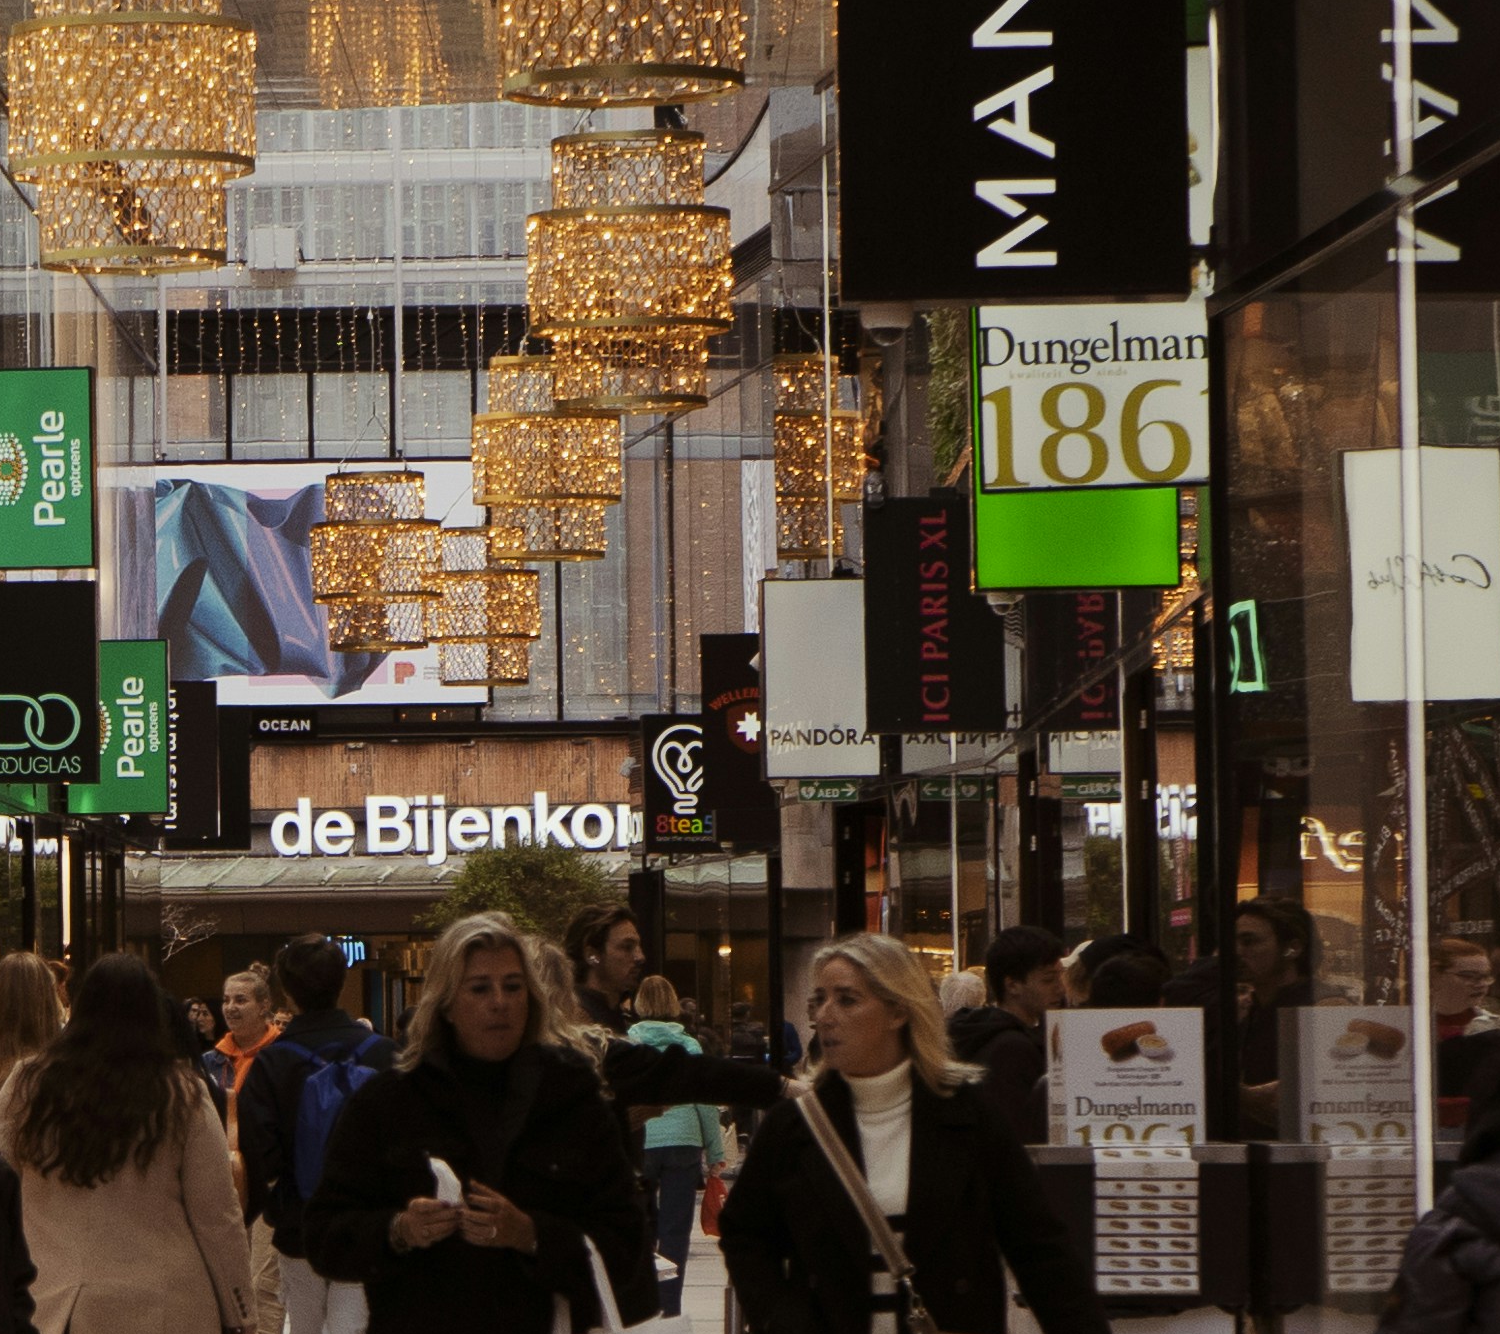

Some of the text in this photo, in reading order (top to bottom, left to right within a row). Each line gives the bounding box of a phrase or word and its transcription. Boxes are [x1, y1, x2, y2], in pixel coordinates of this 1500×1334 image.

[982, 379, 1209, 487] 186
[33, 410, 67, 527] Pearle
[70, 438, 84, 497] opticiens
[919, 509, 950, 723] ICI PARIS XL
[116, 676, 145, 778] Pearle
[148, 701, 159, 753] opticiens
[258, 718, 312, 732] OCEAN
[771, 727, 876, 746] PANDORA
[817, 788, 840, 798] AED
[270, 797, 356, 856] de
[656, 814, 713, 834] 8tea5
[336, 936, 366, 968] ijn
[1075, 1095, 1197, 1121] Dungelmann
